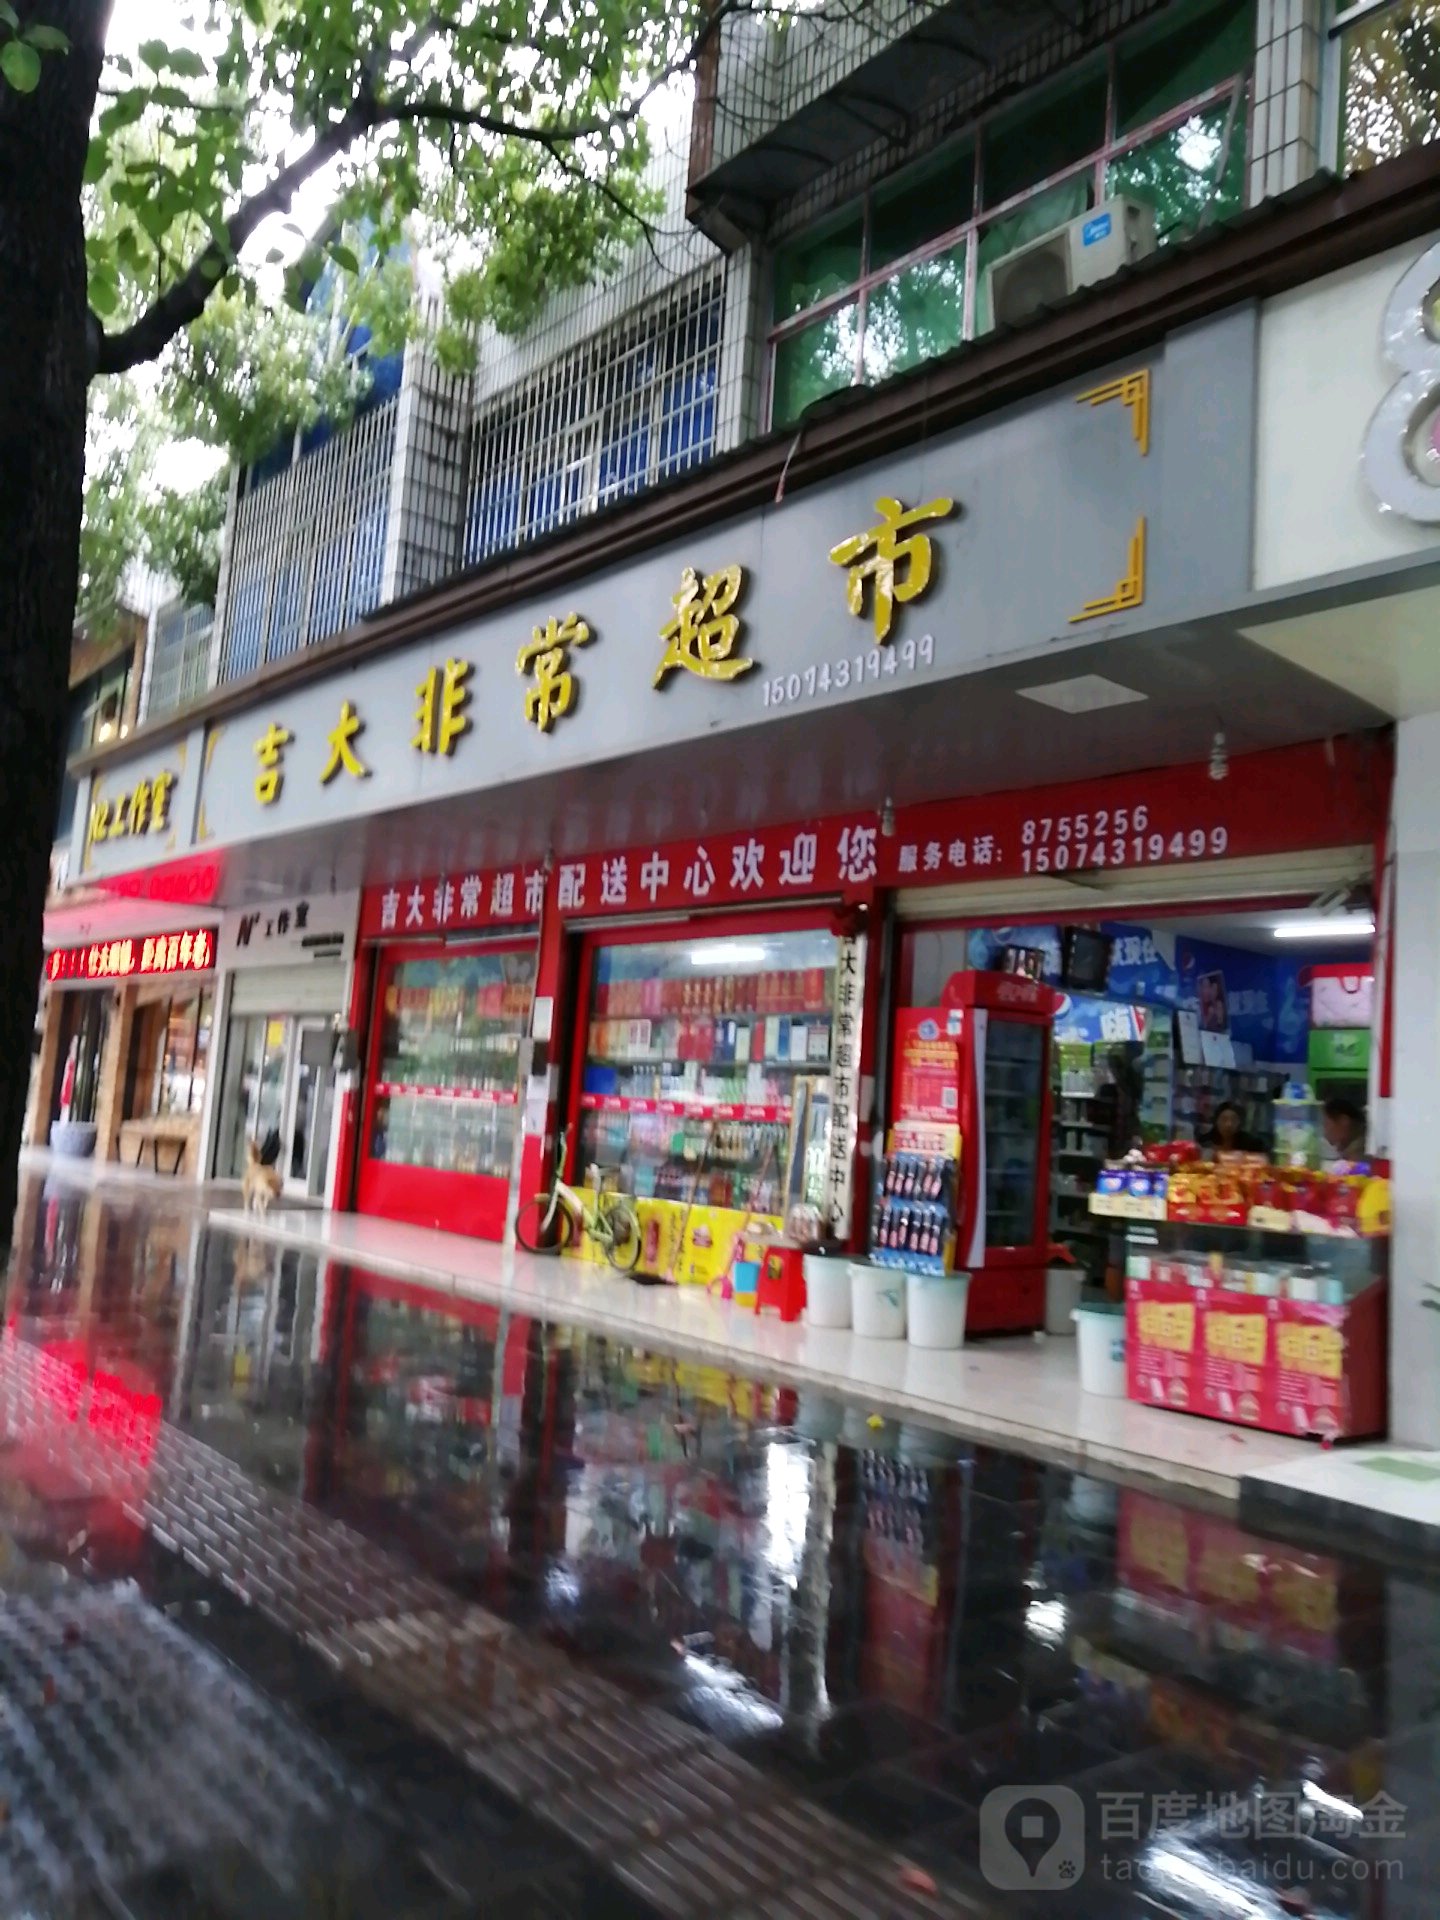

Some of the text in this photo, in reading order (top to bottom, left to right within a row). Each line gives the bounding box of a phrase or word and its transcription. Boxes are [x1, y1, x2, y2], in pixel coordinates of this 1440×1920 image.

[253, 496, 954, 804] 吉大非常超市
[762, 633, 935, 707] 15074319499
[1021, 804, 1149, 846] 8755256
[1021, 826, 1229, 875] 15074319499
